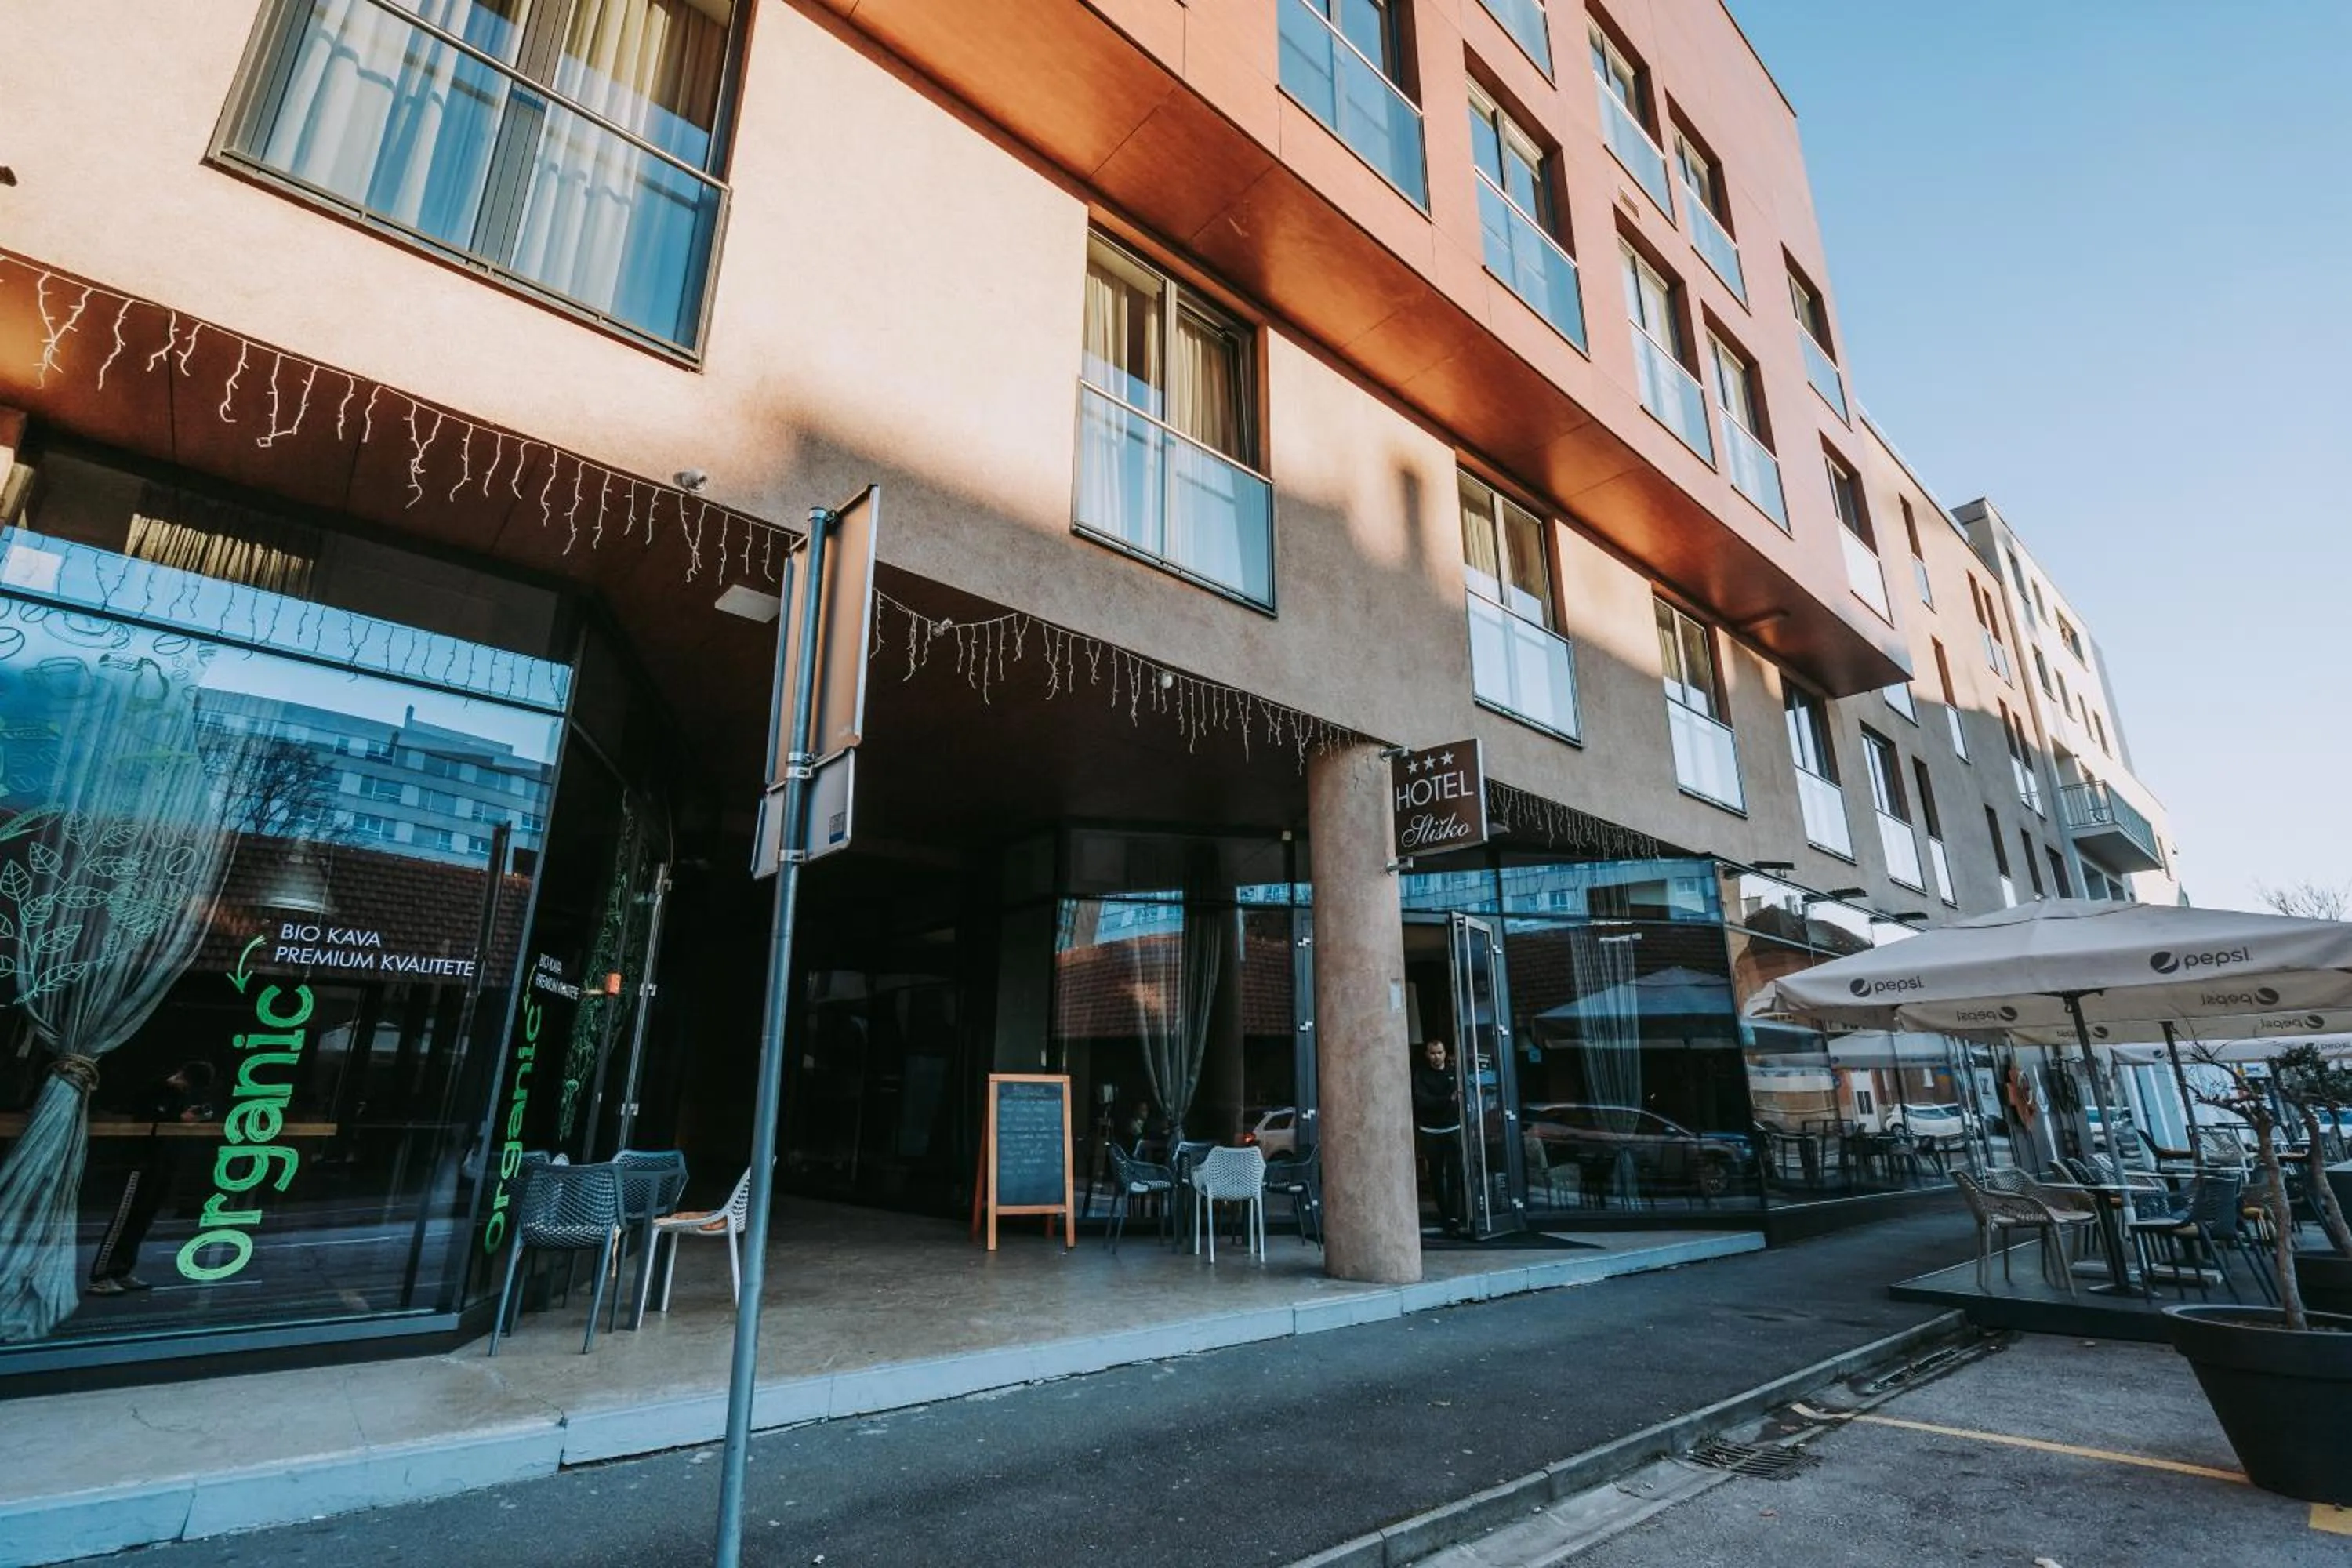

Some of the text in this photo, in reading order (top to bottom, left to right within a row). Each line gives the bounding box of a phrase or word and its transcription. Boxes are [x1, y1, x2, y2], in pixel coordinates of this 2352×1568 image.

[1396, 771, 1474, 811] HOTEL
[1401, 812, 1469, 848] Sliško
[281, 923, 381, 948] BIO KAVA
[274, 946, 475, 976] PREMIUM KVALITETE
[176, 985, 314, 1281] organic
[485, 1005, 542, 1254] organic
